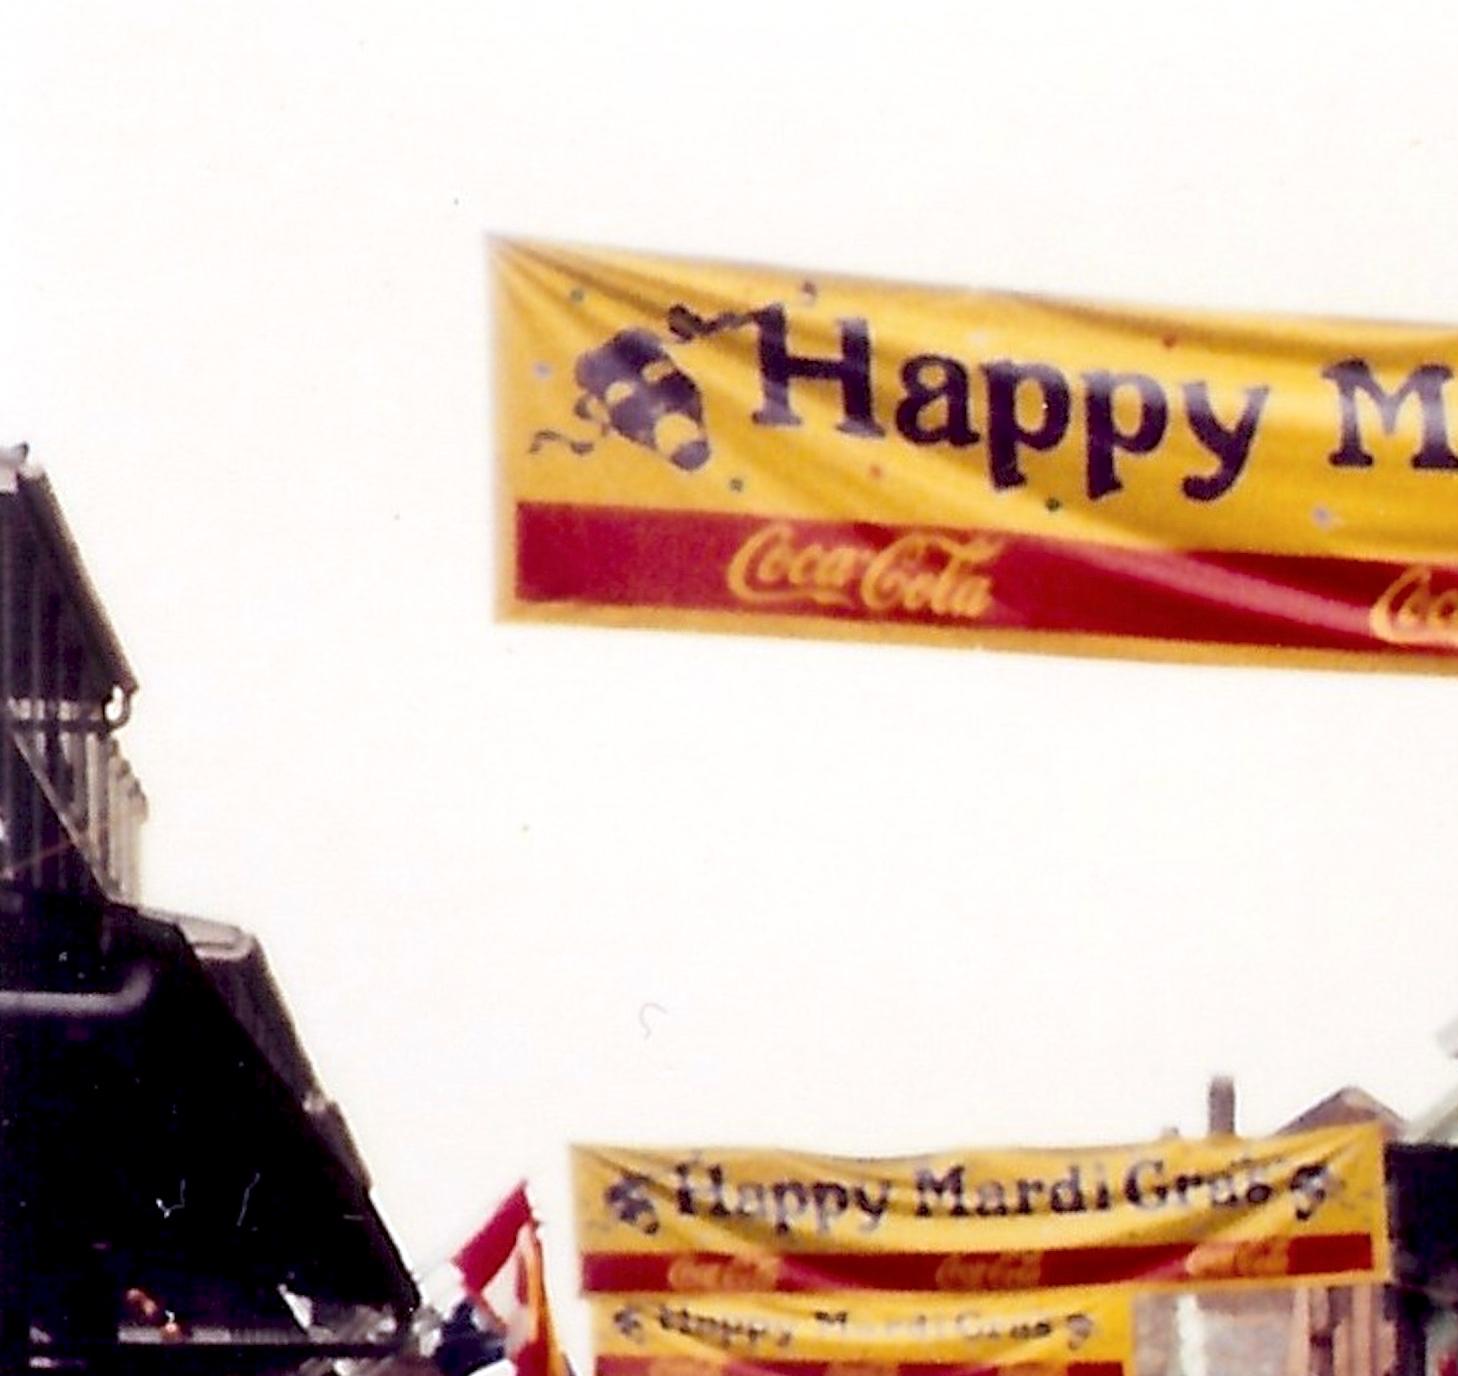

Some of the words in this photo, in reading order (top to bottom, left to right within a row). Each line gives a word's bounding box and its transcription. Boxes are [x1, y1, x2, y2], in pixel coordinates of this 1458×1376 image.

[752, 304, 1270, 502] Happy
[671, 1158, 893, 1236] Happy
[912, 1162, 1112, 1218] Mardi
